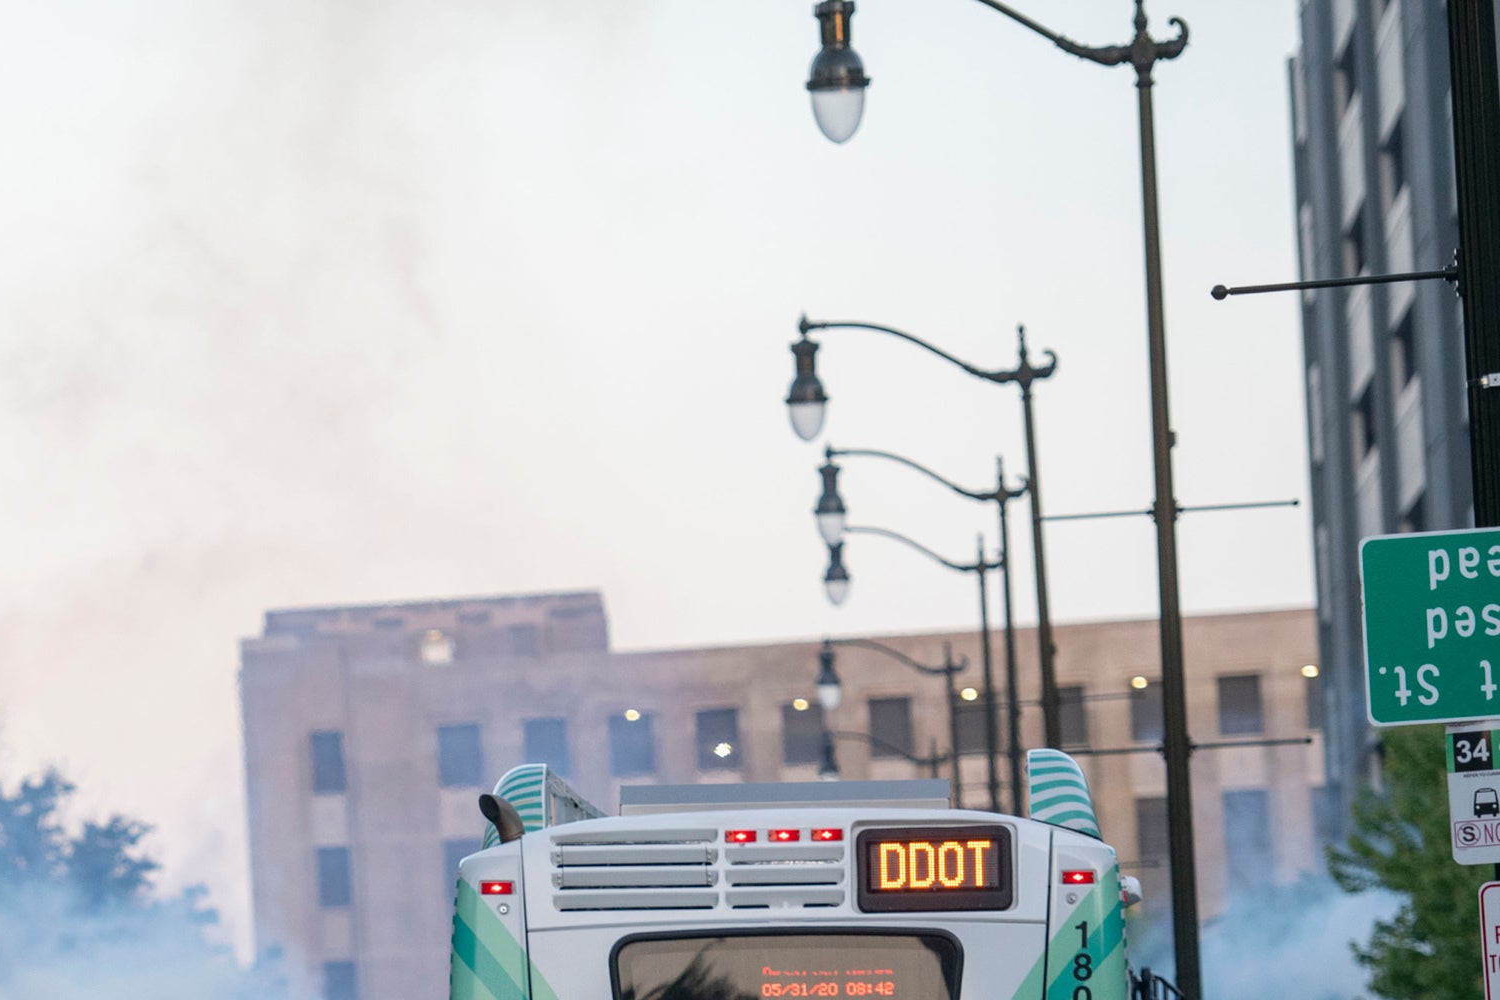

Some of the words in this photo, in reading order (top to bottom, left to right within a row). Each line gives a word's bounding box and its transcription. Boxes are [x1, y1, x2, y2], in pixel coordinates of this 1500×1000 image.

[1378, 663, 1440, 706] St.
[1456, 738, 1490, 764] 34
[879, 840, 991, 889] DDOT
[761, 982, 838, 997] 05/31/20
[845, 981, 895, 996] 08:42
